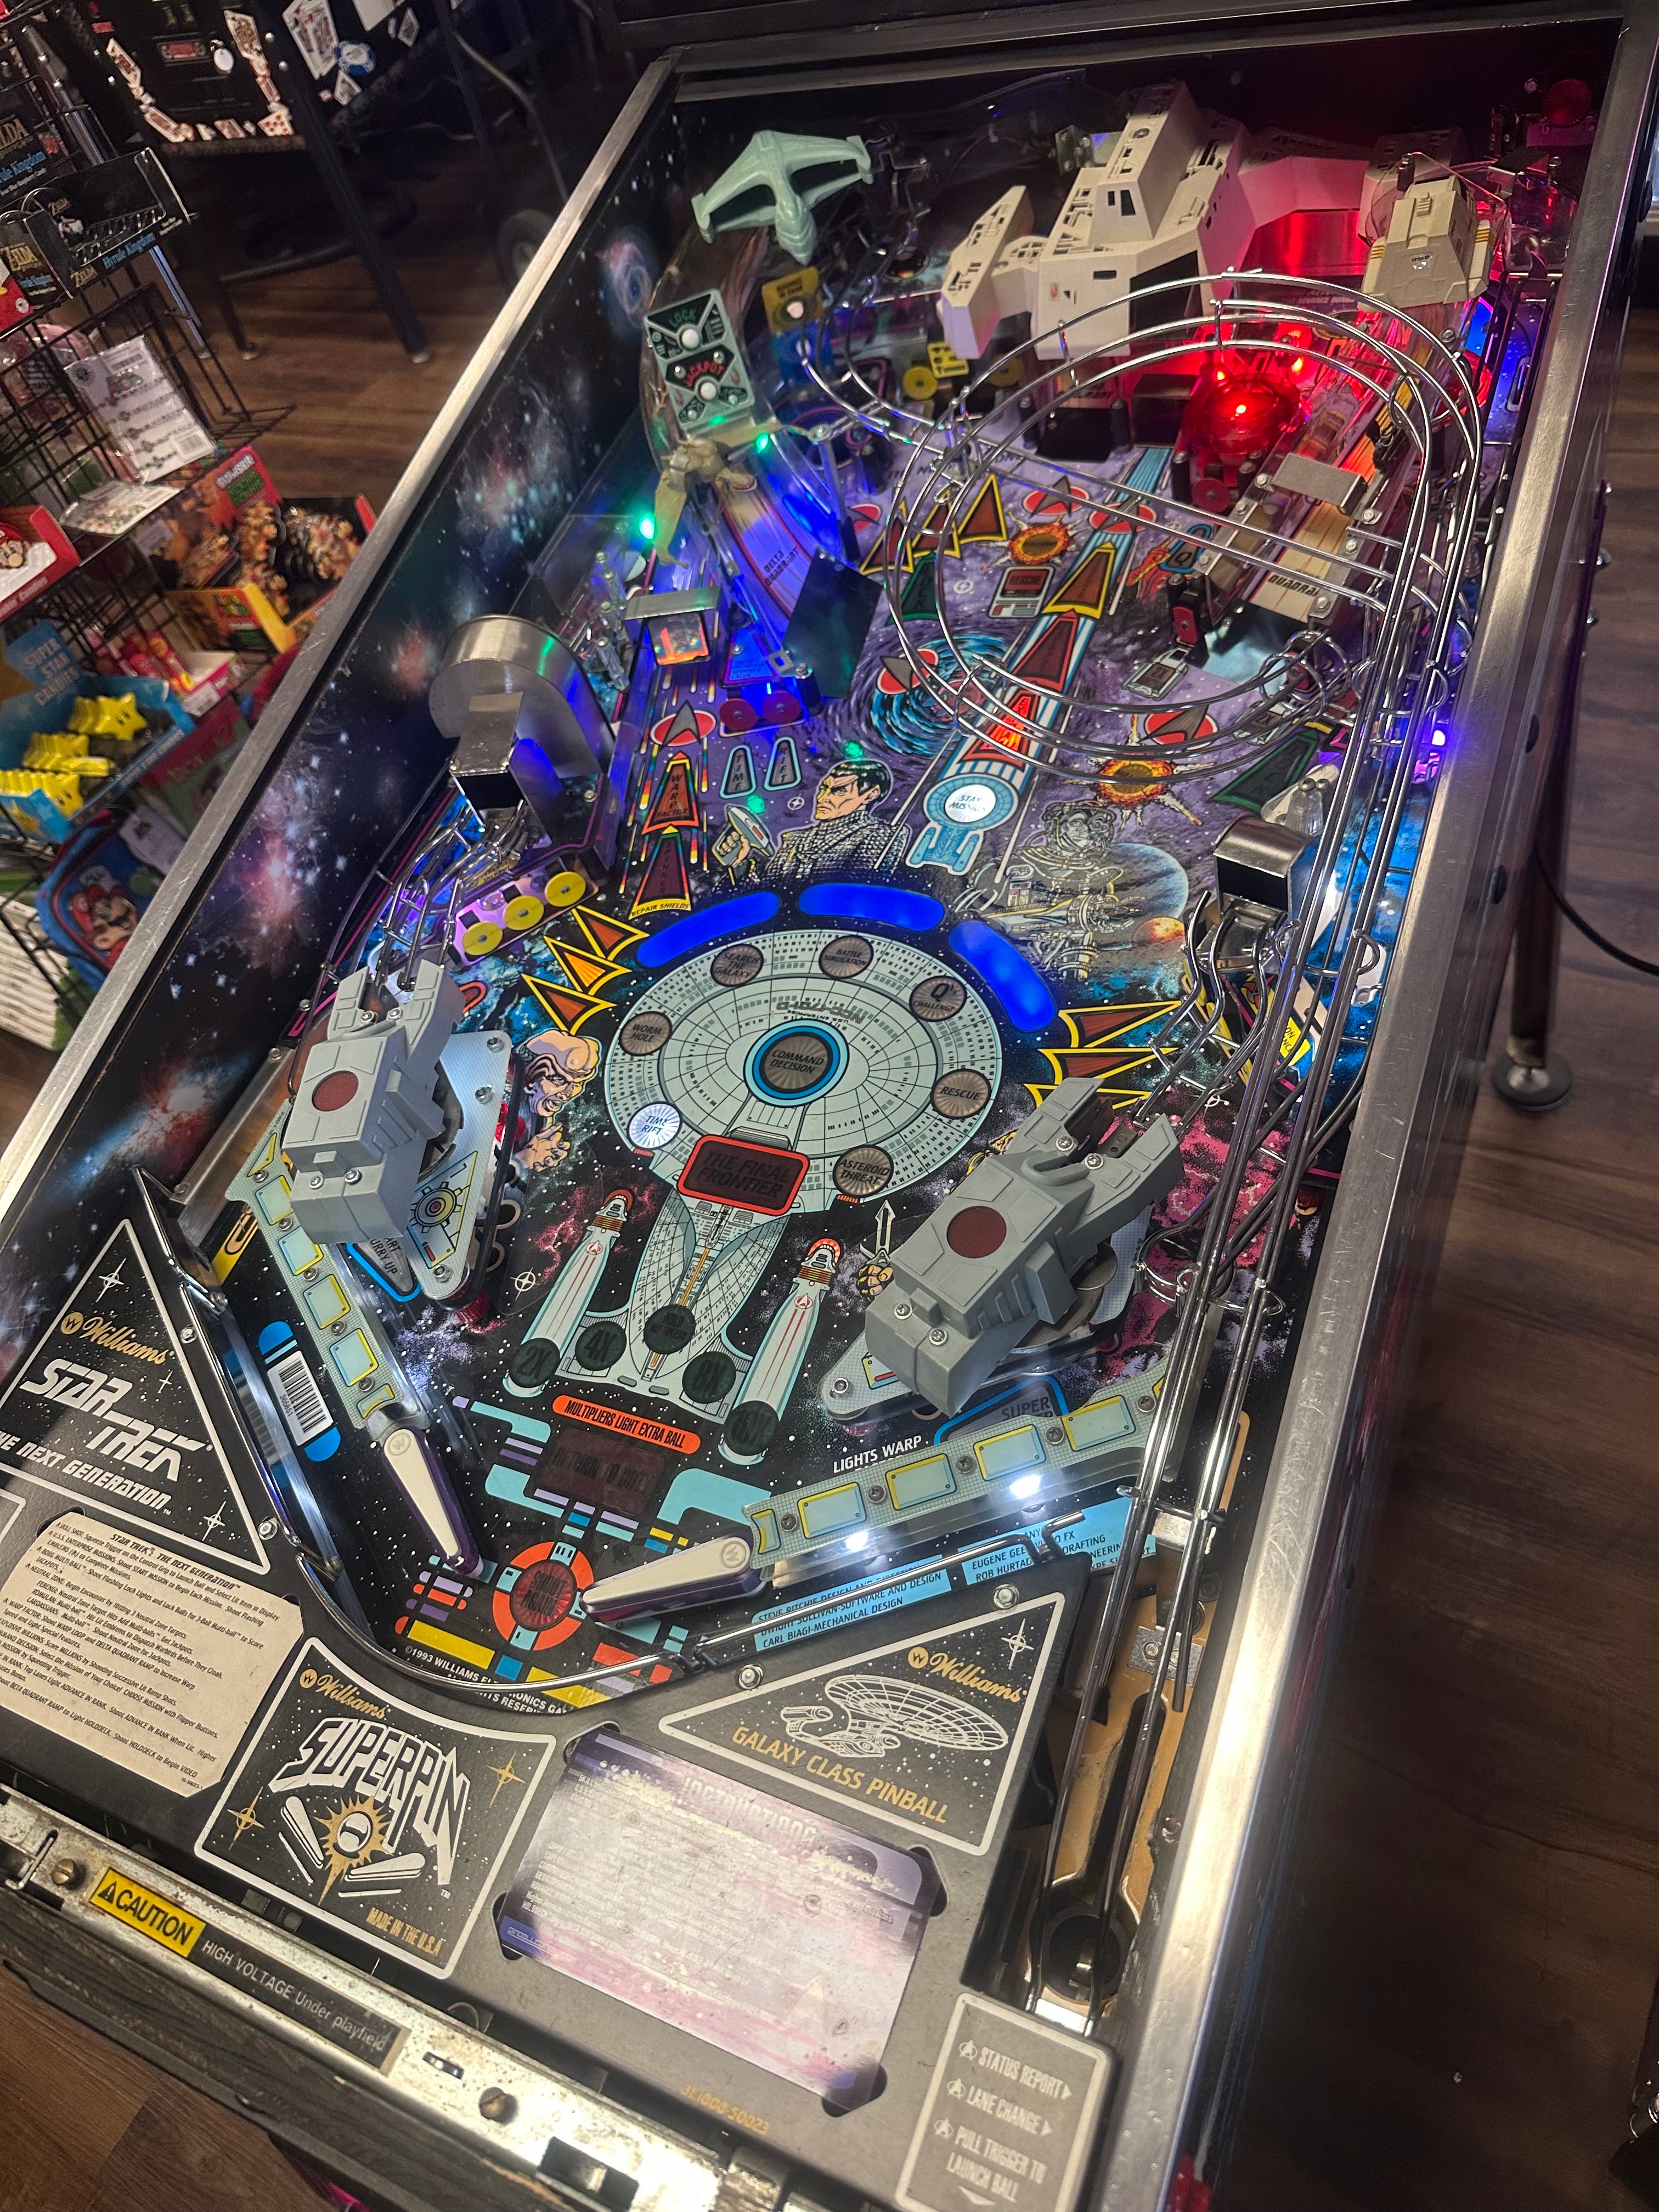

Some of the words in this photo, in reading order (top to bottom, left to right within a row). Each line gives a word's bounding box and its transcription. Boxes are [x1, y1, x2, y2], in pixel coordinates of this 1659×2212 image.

[669, 308, 696, 327] LOCK
[732, 755, 744, 791] TIME
[779, 748, 788, 783] RIFT
[670, 774, 682, 809] WARP
[657, 809, 688, 817] FACTOR
[631, 905, 657, 917] REPAIR
[724, 952, 760, 964] SEARCH
[729, 961, 745, 970] THE
[825, 955, 867, 967] SIMULATION
[836, 949, 862, 957] BATTLE
[715, 968, 753, 979] GALAXY
[930, 983, 957, 1000] Q's
[913, 1000, 955, 1013] CHALLENGE
[633, 1023, 661, 1034] WORM
[633, 1032, 655, 1042] HOLE
[770, 1059, 816, 1074] DECISION
[772, 1049, 824, 1065] COMMAND
[940, 1086, 982, 1100] RESCUE
[641, 1125, 662, 1135] RIFT
[646, 1115, 670, 1125] TIME
[703, 1153, 738, 1170] THE
[738, 1160, 791, 1182] FINAL
[839, 1159, 890, 1176] ASTEROID
[840, 1169, 879, 1184] THREAT
[697, 1167, 784, 1198] FRONTIER
[370, 1239, 390, 1260] URRY
[385, 1263, 398, 1274] UP
[584, 1331, 620, 1359] 4X
[19, 1358, 133, 1417] STAR
[280, 1393, 294, 1416] 365851
[565, 1401, 616, 1426] MULTIPLIERS
[614, 1414, 638, 1430] LIGHT
[638, 1421, 663, 1441] EXTRA
[664, 1431, 686, 1449] BALL
[0, 1431, 20, 1451] HE
[16, 1442, 65, 1468] NEXT
[833, 1448, 878, 1474] LIGHTS
[882, 1435, 922, 1456] WARP
[59, 1523, 72, 1532] SKILL
[83, 1533, 105, 1547] Squeeze
[104, 1542, 123, 1554] Trigger
[129, 1553, 139, 1561] the
[138, 1556, 160, 1570] Control
[158, 1565, 170, 1575] Grip
[175, 1572, 195, 1584] Launch
[194, 1579, 206, 1589] Ball
[204, 1585, 217, 1594] and
[215, 1589, 232, 1601] Select
[230, 1596, 240, 1604] Lit
[239, 1599, 253, 1610] Item
[156, 1553, 173, 1564] THE
[170, 1559, 191, 1571] NEXT
[972, 1552, 1006, 1570] EUGENE
[1009, 1545, 1026, 1557] GEE
[976, 1570, 994, 1582] ROB
[997, 1558, 1032, 1575] HURTAD
[888, 1582, 907, 1595] AND
[910, 1572, 941, 1589] DESIGN
[30, 1565, 52, 1578] NEUTRAL
[65, 1581, 81, 1592] Begin
[80, 1587, 107, 1602] Encounter
[105, 1599, 114, 1607] by
[112, 1602, 132, 1615] Hitting
[135, 1612, 156, 1625] Neutral
[153, 1620, 168, 1630] Zone
[763, 1635, 785, 1647] CARL
[788, 1609, 869, 1640] BIAGI-MECHANICAL
[871, 1597, 903, 1614] DESIGN
[434, 1657, 479, 1682] WILLIAMS
[733, 1726, 806, 1765] GALAXY
[806, 1756, 864, 1789] CLASS
[866, 1777, 949, 1824] PINBALL
[268, 1717, 471, 1885] SUPERPIN
[366, 1907, 393, 1932] MADE
[390, 1918, 404, 1937] IN
[401, 1923, 421, 1945] THE
[116, 1888, 194, 1946] CAUTION
[202, 1940, 233, 1966] HIGH
[236, 1960, 294, 2000] VOLTAGE
[295, 1992, 331, 2020] Under
[332, 2015, 386, 2052] playfield
[978, 2046, 1020, 2080] STATUS
[1019, 2064, 1063, 2098] REPORT
[967, 2086, 998, 2114] LANE
[996, 2098, 1041, 2135] CHANGE
[955, 2125, 981, 2155] PULL
[984, 2138, 1029, 2176] TRIGGER
[1030, 2159, 1046, 2185] TO
[946, 2152, 992, 2190] LAUNCH
[991, 2172, 1018, 2203] BALL
